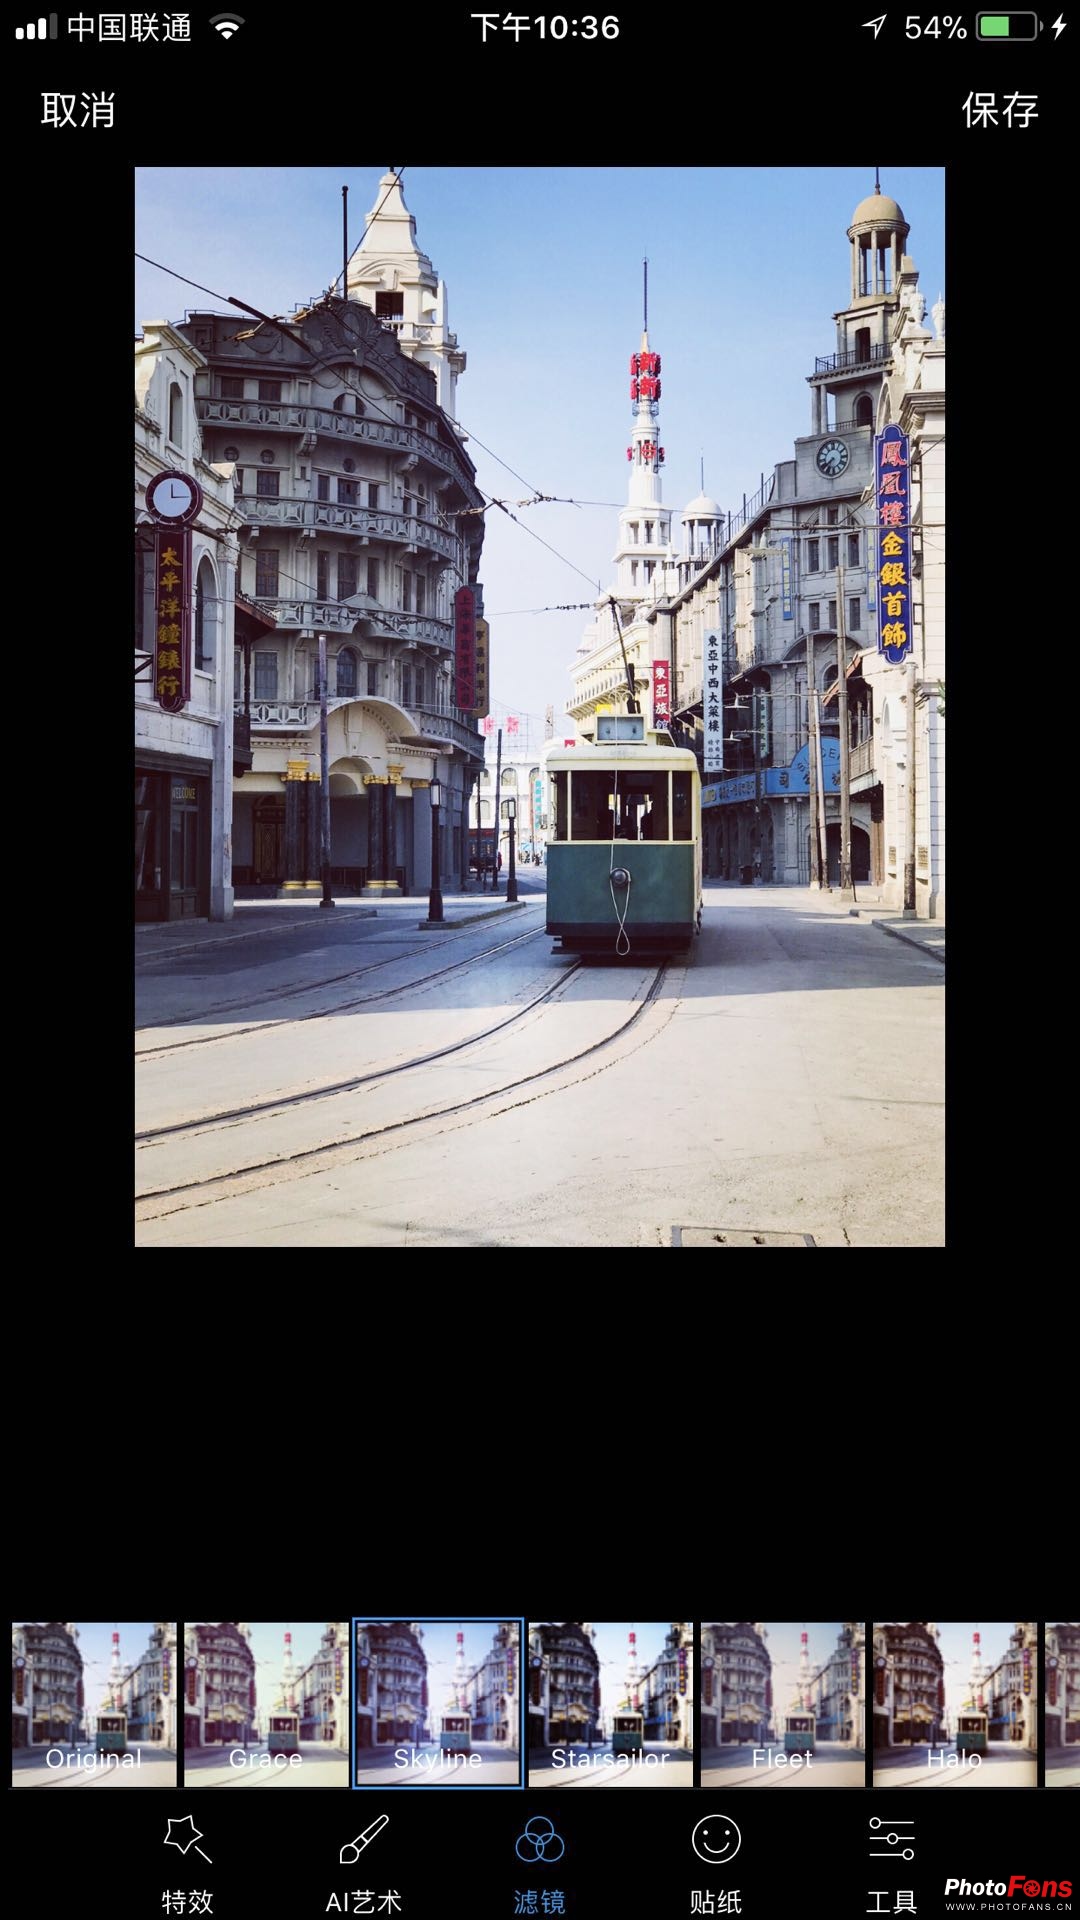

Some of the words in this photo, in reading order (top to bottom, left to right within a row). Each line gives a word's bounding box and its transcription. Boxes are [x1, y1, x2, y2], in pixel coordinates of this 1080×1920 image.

[67, 12, 192, 43] 中国联通
[470, 12, 620, 43] 下午10:36
[905, 15, 968, 40] 54%
[40, 91, 116, 128] 取消
[961, 91, 1039, 128] 保存
[879, 440, 907, 649] 鳳凰樓金銀首飾
[156, 546, 183, 697] 太平洋鐘錶行
[45, 1749, 141, 1774] Original
[229, 1749, 302, 1769] Grace
[394, 1749, 482, 1775] Skyline
[551, 1749, 670, 1769] Starsailor
[753, 1749, 813, 1769] Fleet
[927, 1749, 982, 1769] Halo
[162, 1889, 213, 1915] 特效
[325, 1889, 402, 1915] AI艺术
[514, 1889, 566, 1915] 滤镜
[690, 1889, 742, 1915] 贴纸
[866, 1889, 917, 1915] 工具
